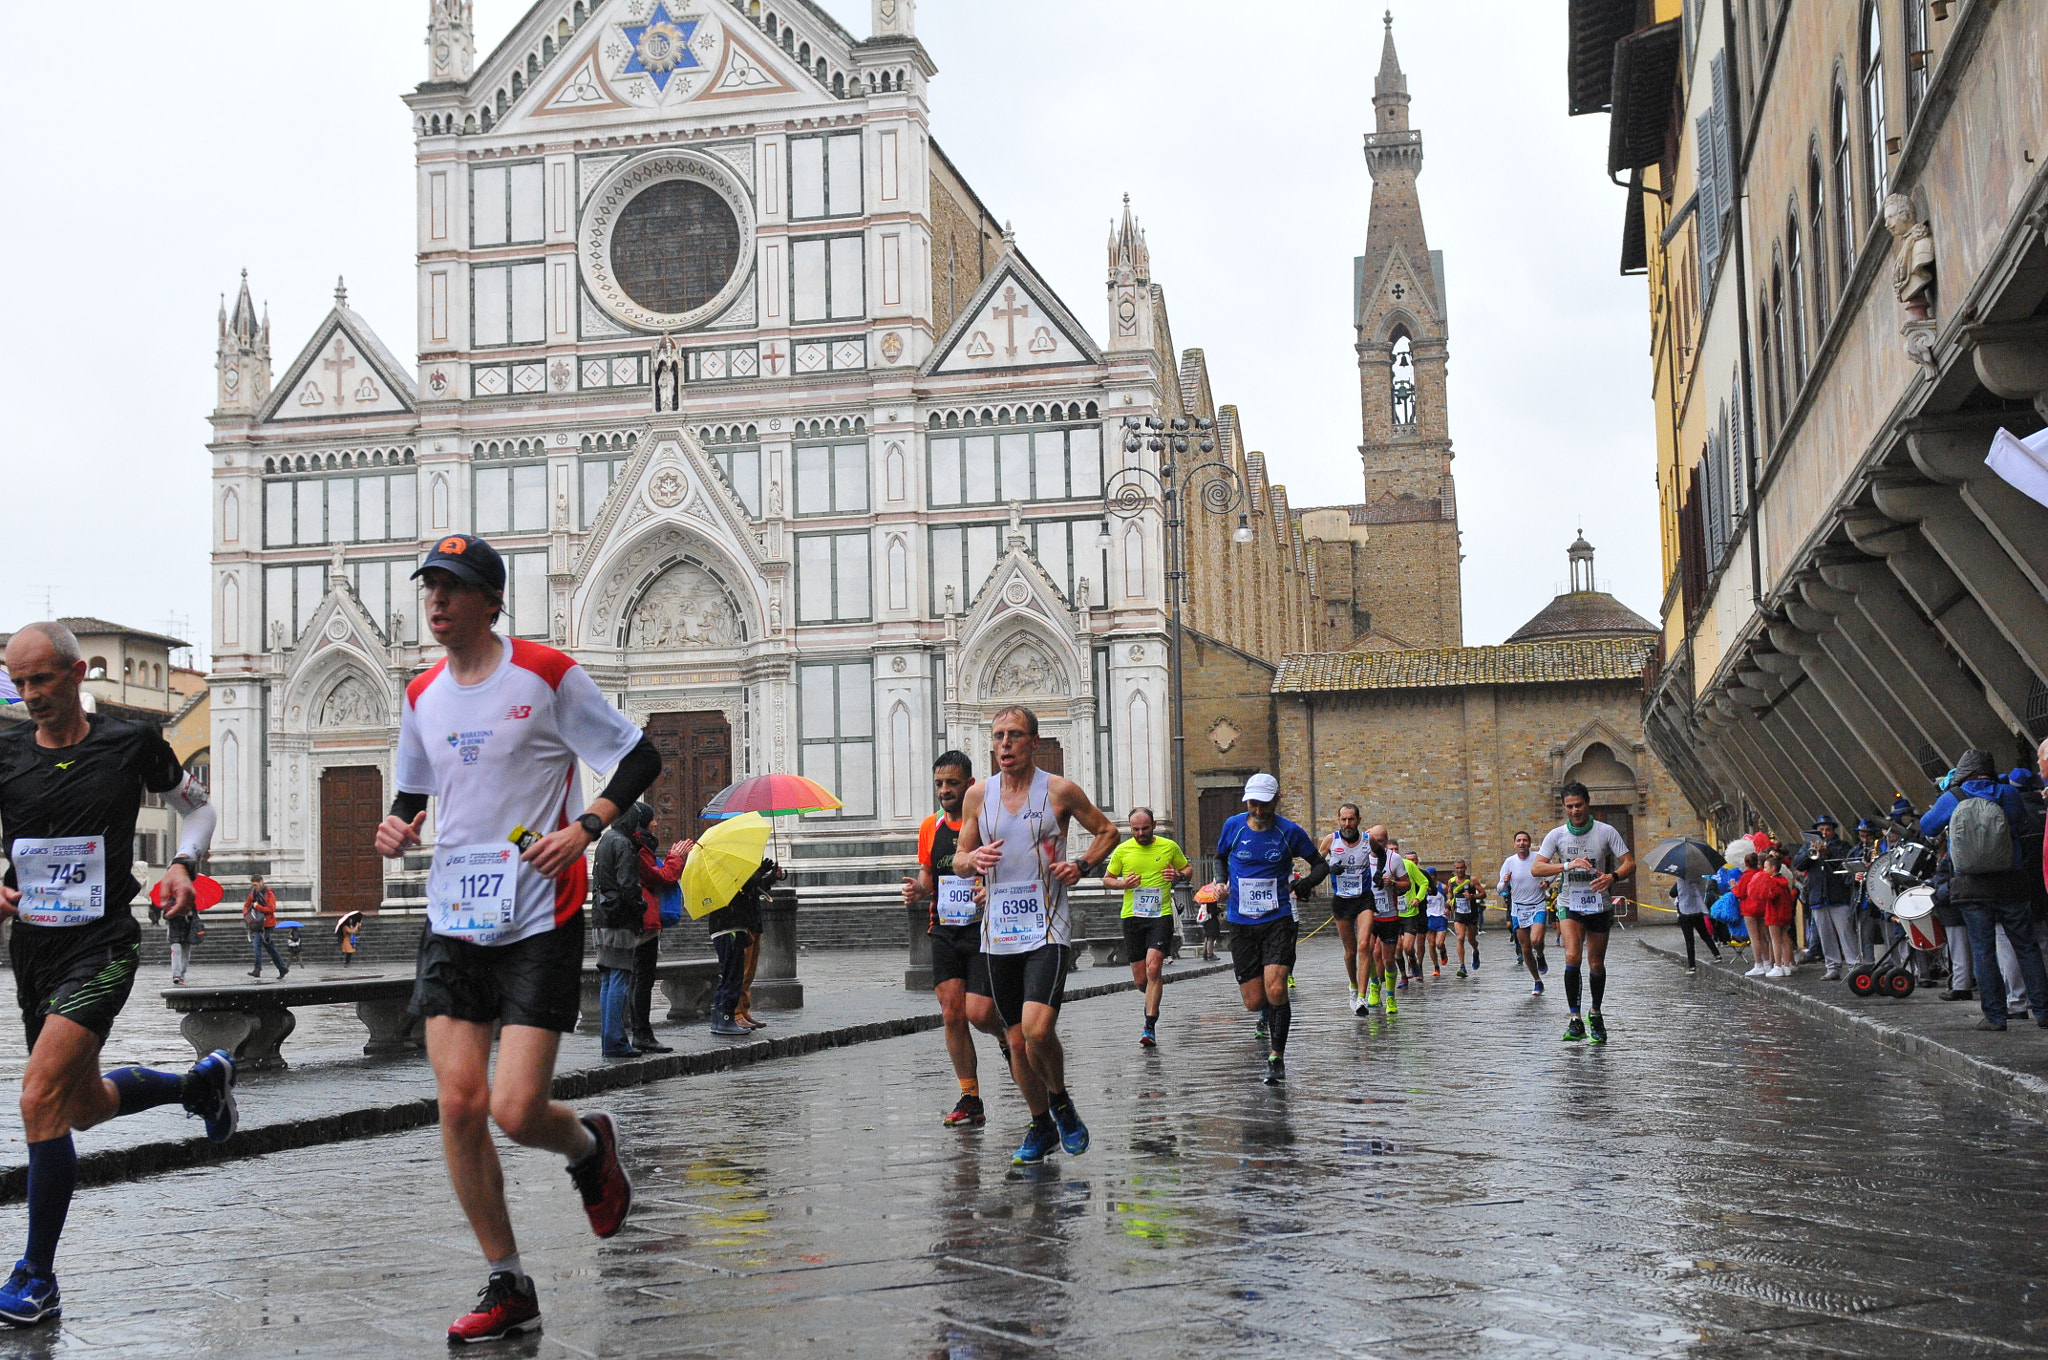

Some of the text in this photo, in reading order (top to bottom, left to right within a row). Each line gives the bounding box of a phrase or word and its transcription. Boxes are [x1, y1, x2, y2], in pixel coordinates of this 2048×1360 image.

[47, 863, 87, 884] 745
[460, 873, 504, 899] 1127
[1140, 895, 1160, 904] 5778
[1249, 889, 1273, 901] 3615
[1580, 895, 1597, 905] 840
[1002, 898, 1038, 915] 6398
[30, 914, 58, 923] CONAD
